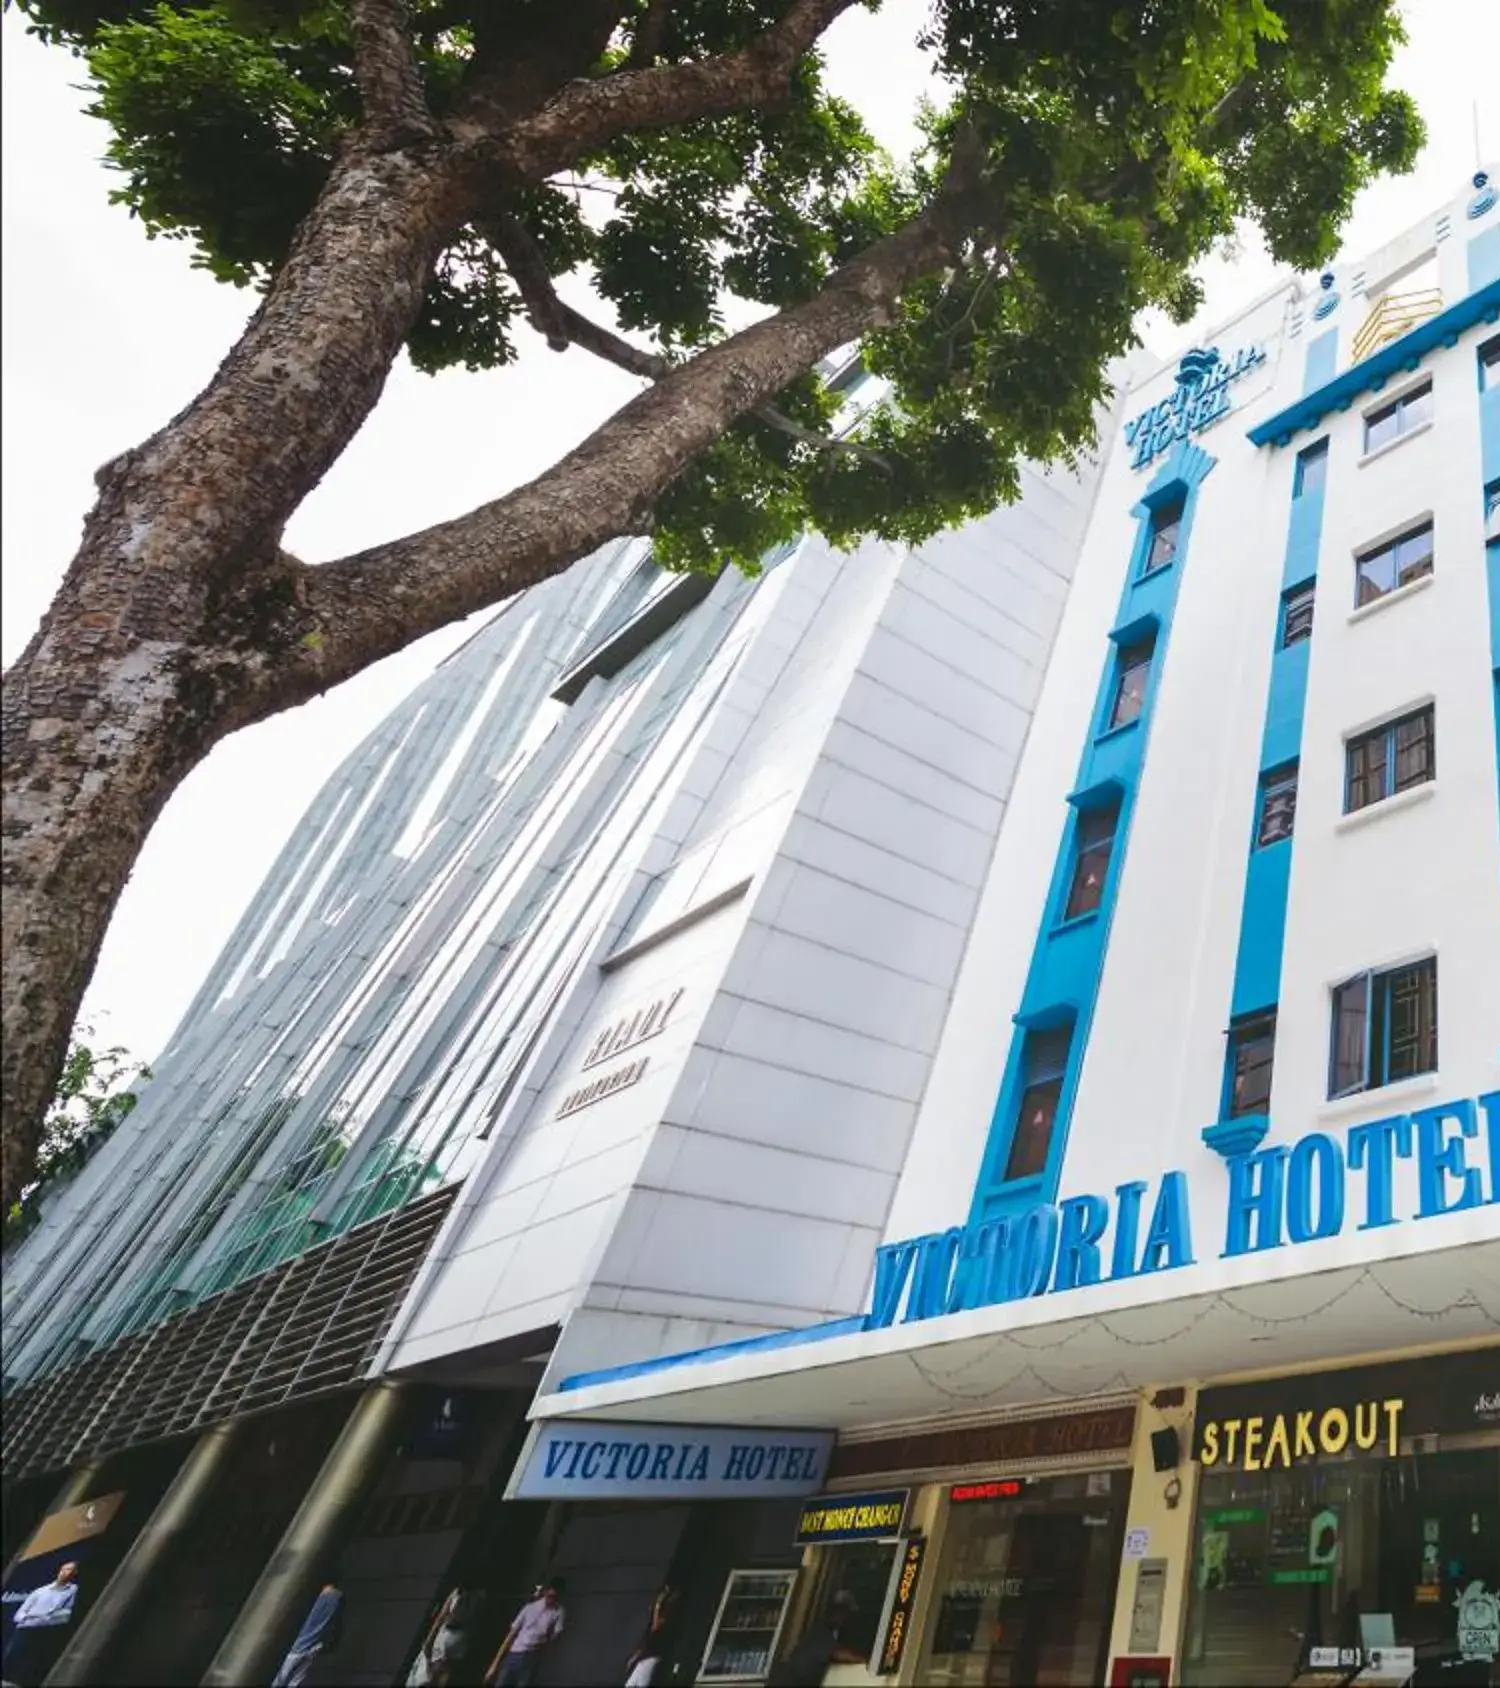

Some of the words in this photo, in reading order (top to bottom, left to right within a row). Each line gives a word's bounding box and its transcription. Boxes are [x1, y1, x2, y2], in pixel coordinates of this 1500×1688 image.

[1124, 346, 1266, 446] VICTORIA
[1131, 388, 1230, 470] HOTEL
[868, 1170, 1197, 1330] VICTORIA
[544, 1441, 710, 1480] VICTORIA
[721, 1445, 821, 1481] HOTEL
[1201, 1399, 1404, 1471] STEAKOUT
